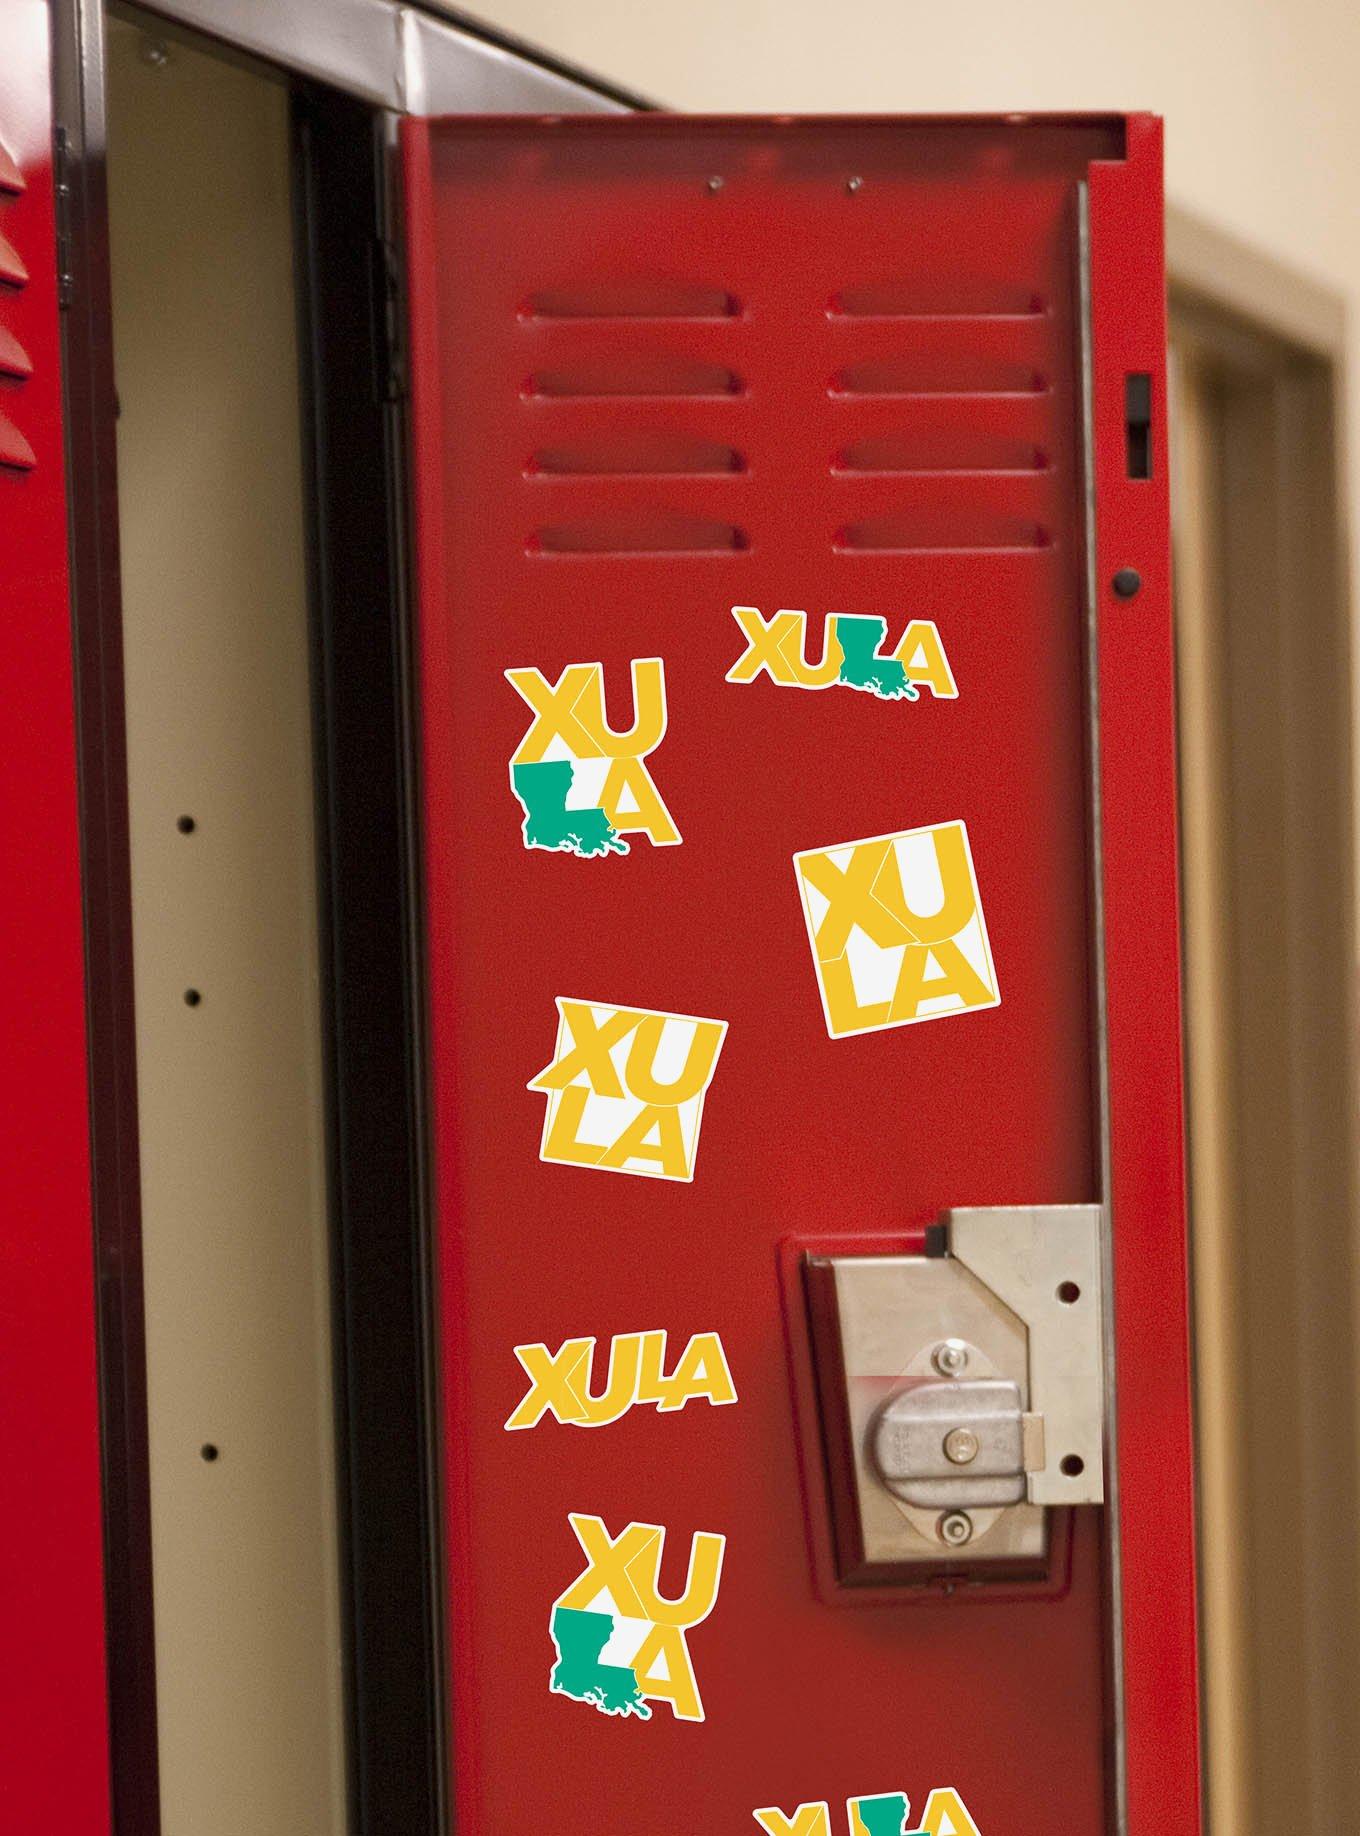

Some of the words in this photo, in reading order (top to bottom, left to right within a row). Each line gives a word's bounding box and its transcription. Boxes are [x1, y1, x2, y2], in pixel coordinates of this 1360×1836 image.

[506, 660, 667, 760] XU
[797, 824, 977, 961] XU
[819, 938, 996, 1034] LA
[531, 1001, 724, 1104] XU
[543, 1085, 691, 1179] LA
[506, 1332, 736, 1427] XULA
[556, 1515, 724, 1626] XU
